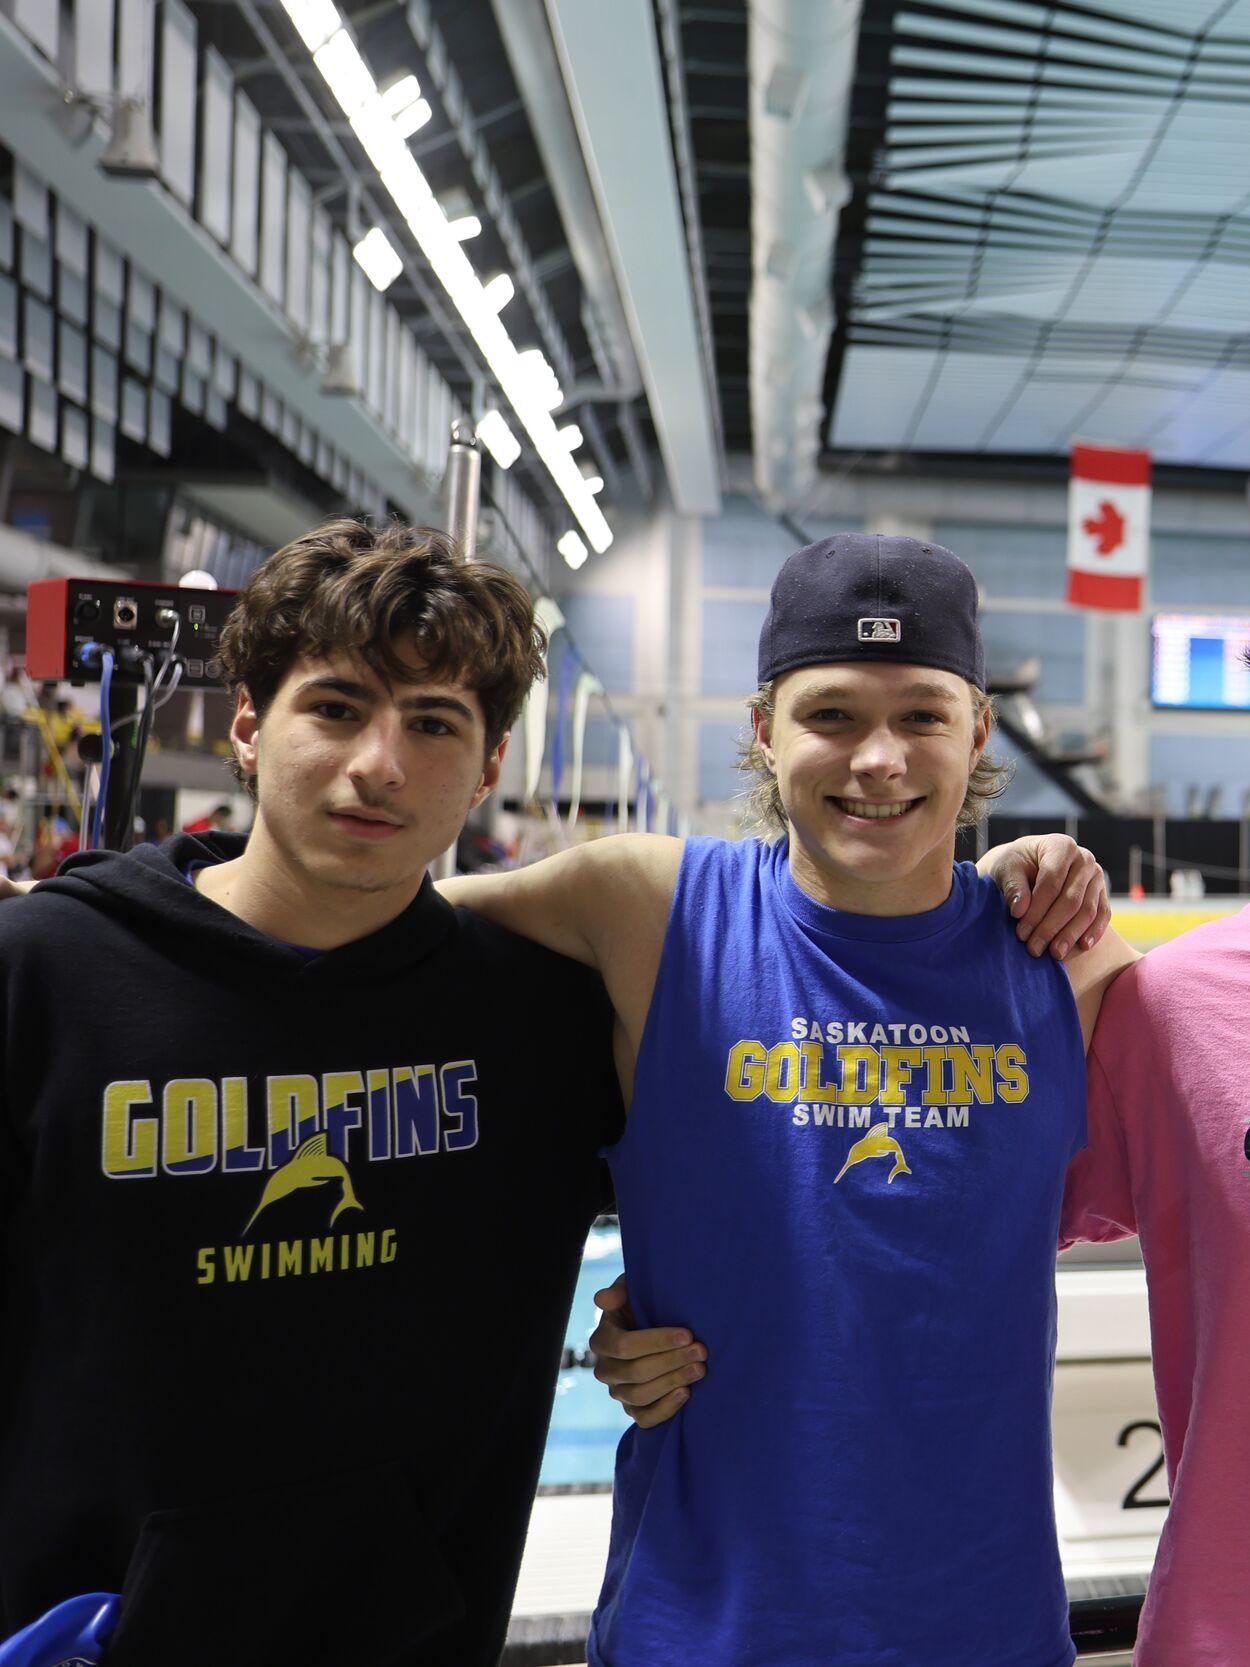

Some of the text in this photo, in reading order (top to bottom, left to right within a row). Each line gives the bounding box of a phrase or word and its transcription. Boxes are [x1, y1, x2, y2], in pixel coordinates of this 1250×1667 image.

[791, 1017, 971, 1045] SASKATOON
[724, 1039, 1029, 1106] GOLDFINS
[102, 1059, 480, 1179] GOLDFINS
[792, 1104, 970, 1128] SWIM TEAM
[197, 1228, 398, 1284] SWIMMING
[1117, 1420, 1172, 1509] 2
